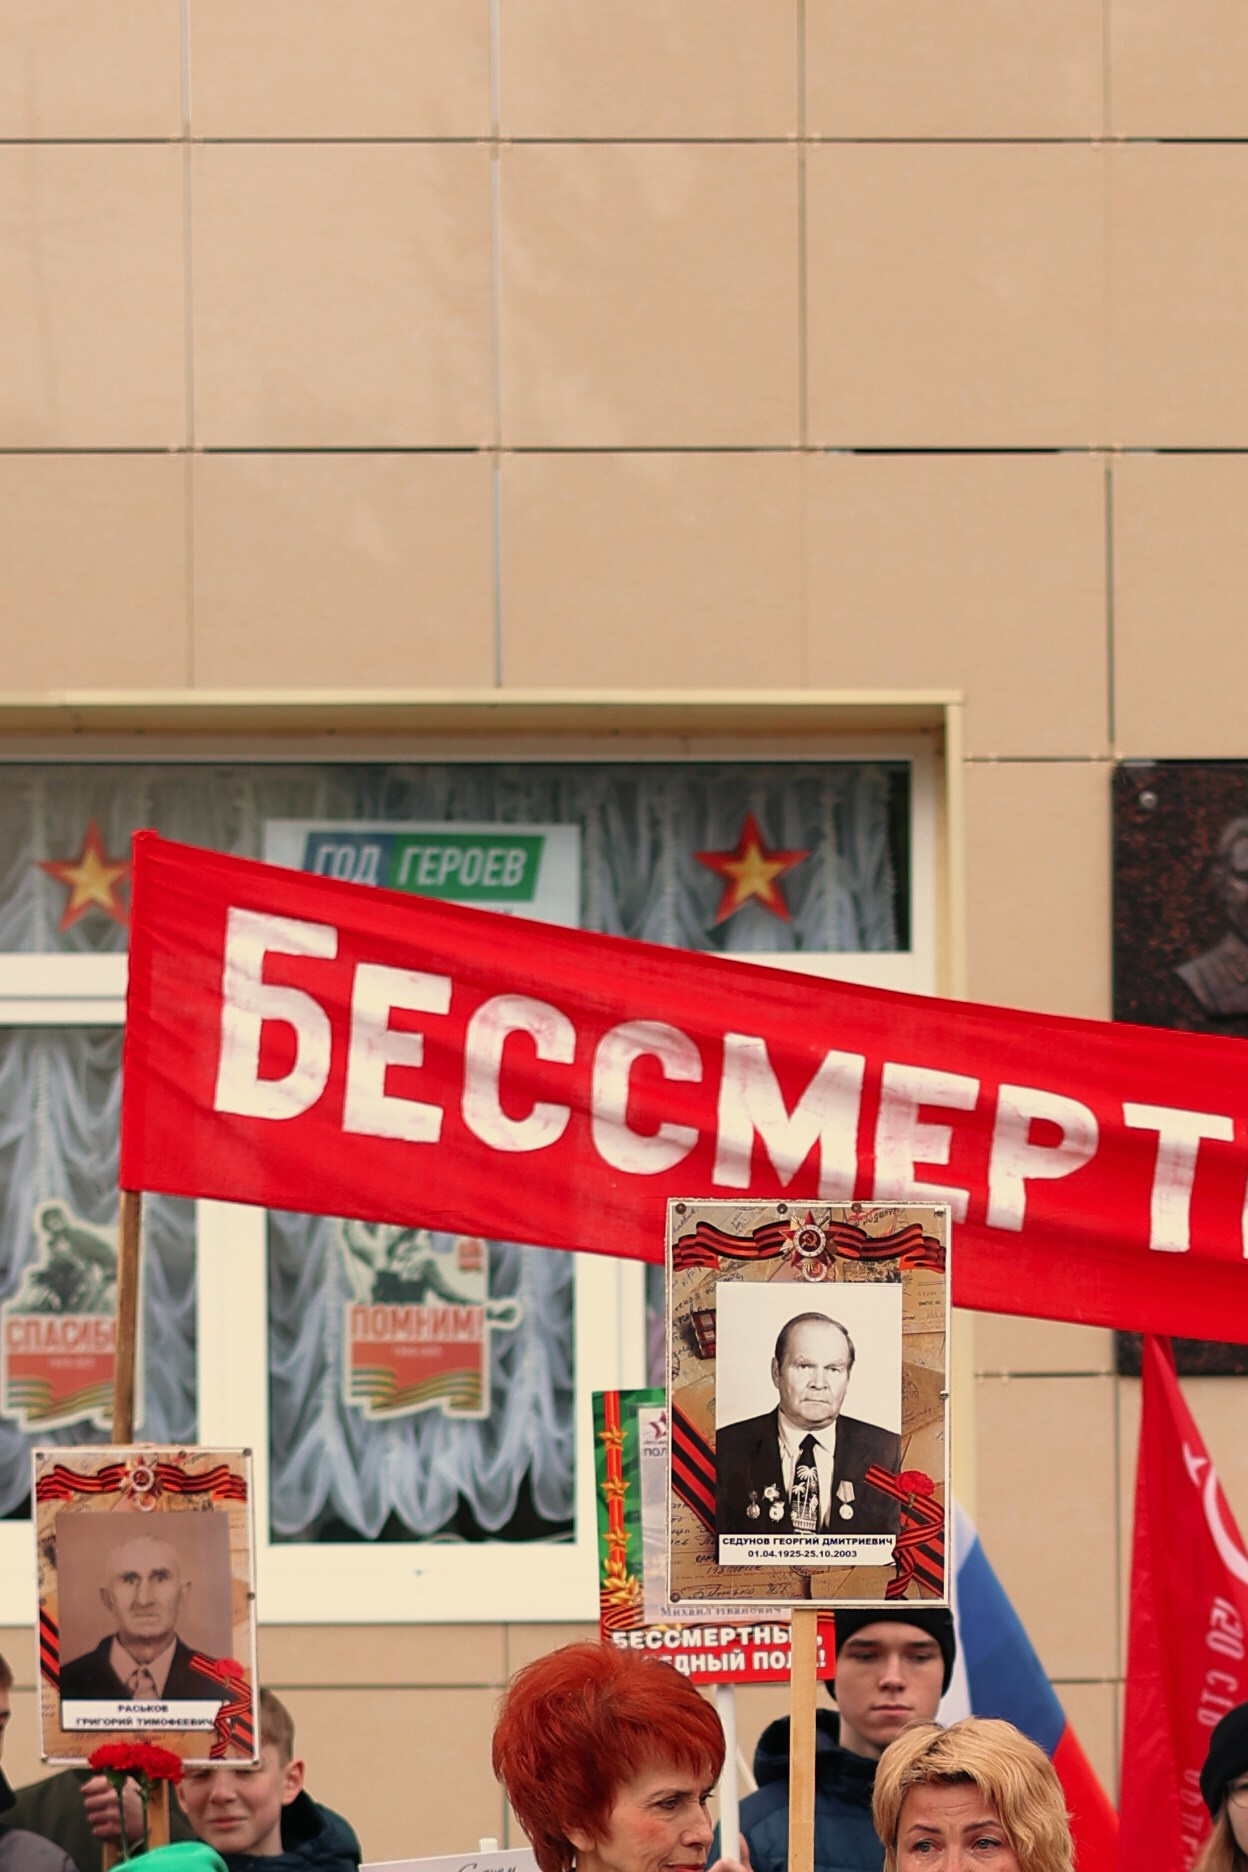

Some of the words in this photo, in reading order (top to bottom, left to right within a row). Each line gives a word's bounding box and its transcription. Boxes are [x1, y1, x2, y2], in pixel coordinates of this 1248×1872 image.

[314, 843, 384, 886] ГОД
[395, 846, 528, 888] ГЕРОЕВ
[352, 1305, 486, 1341] ПОМНИМ!
[6, 1318, 118, 1348] СПАСИБ
[722, 1537, 770, 1547] СЕДУНОВ
[773, 1536, 819, 1546] ГЕОРГИЙ
[822, 1537, 893, 1547] ДМИТРИЕВИЧ
[748, 1549, 857, 1558] 01.04.1925-25.10.2003
[661, 1606, 712, 1617] Михаил
[118, 1704, 168, 1713] РАСЬКОВ
[76, 1717, 133, 1726] ГРИГОРИЙ
[137, 1717, 213, 1727] ТИМОФЕЕВИЧ
